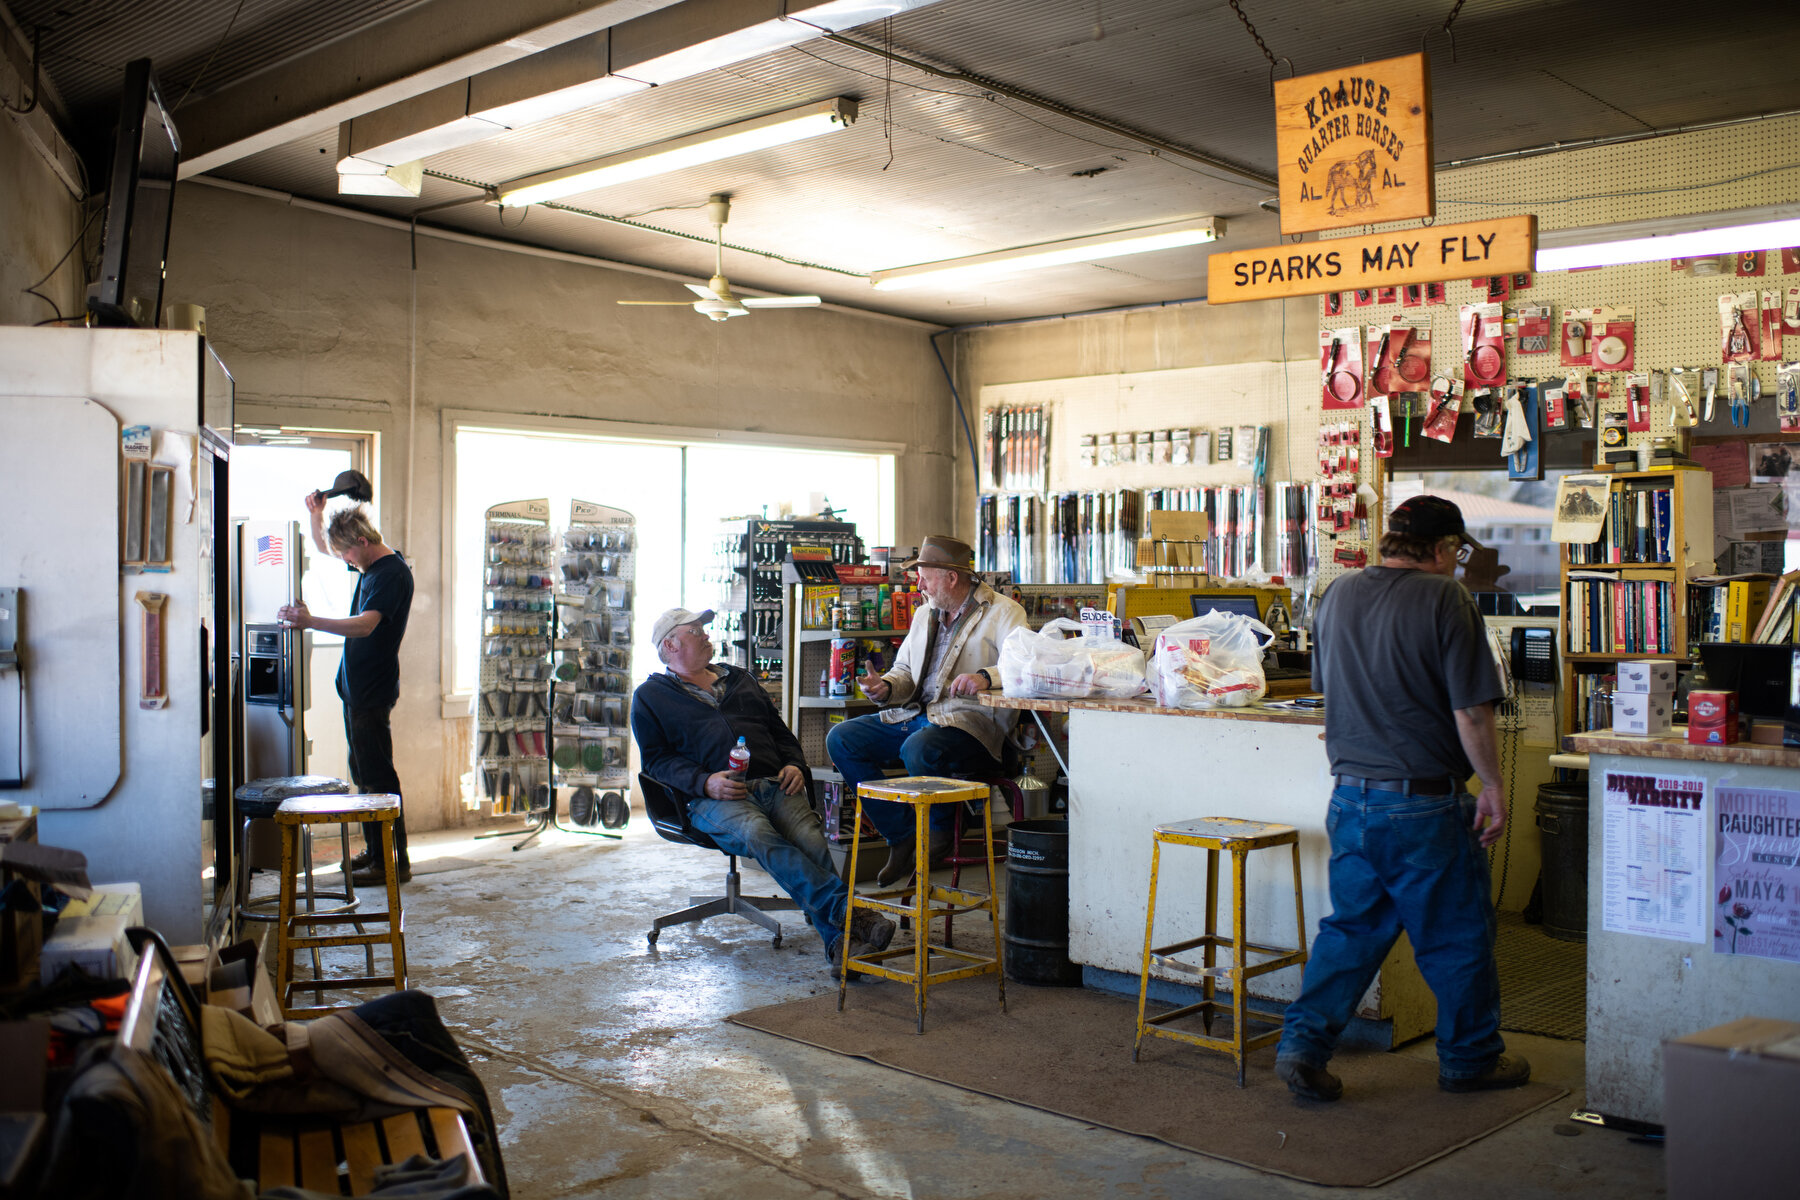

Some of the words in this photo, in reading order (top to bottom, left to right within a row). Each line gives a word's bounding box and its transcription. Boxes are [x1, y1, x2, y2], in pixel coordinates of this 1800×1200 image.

[1304, 77, 1390, 130] KRAUSE
[1298, 113, 1351, 174] QUARTER
[1355, 113, 1405, 162] HORSES
[1382, 168, 1406, 189] AL
[1299, 182, 1323, 203] AL
[1234, 252, 1342, 286] SPARKS
[1361, 242, 1420, 273] MAY
[1441, 233, 1496, 265] FLY
[1658, 779, 1703, 791] 2018-2019
[1627, 789, 1703, 810] VARSITY
[1719, 793, 1788, 815] MOTHER
[1735, 879, 1772, 900] MAY
[1775, 883, 1785, 902] 4
